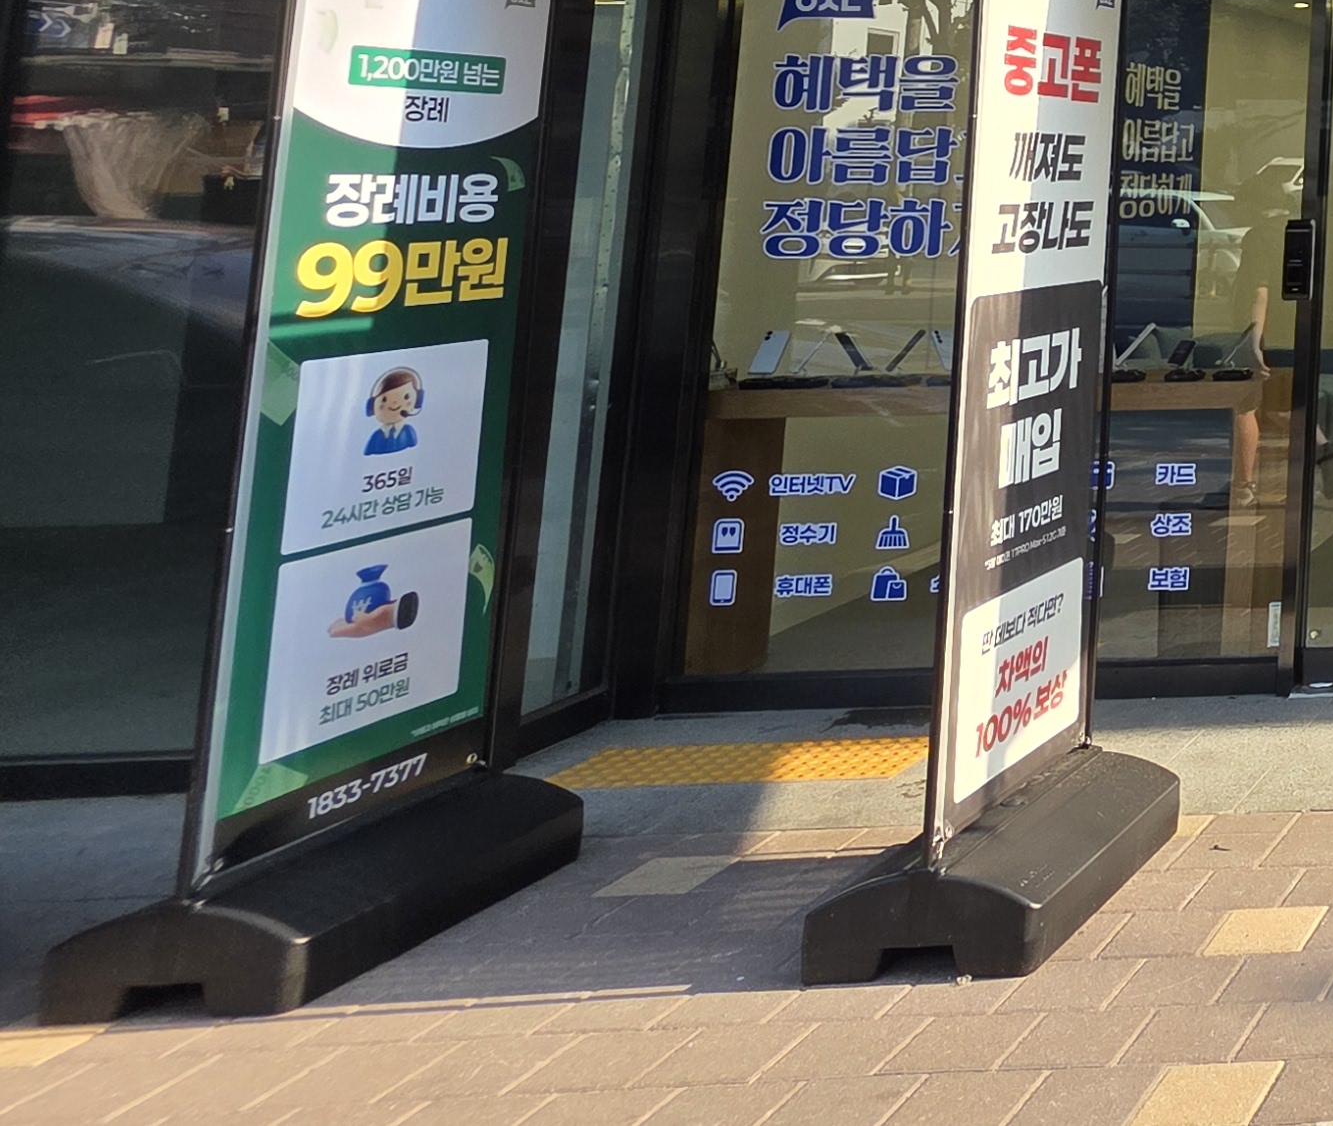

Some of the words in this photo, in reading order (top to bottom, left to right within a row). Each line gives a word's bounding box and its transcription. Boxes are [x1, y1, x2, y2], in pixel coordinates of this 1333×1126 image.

[356, 52, 461, 85] 1,200만원
[463, 59, 501, 88] 넘는
[773, 53, 961, 113] 혜택을
[1003, 24, 1102, 104] 중고폰
[1124, 61, 1182, 111] 혜택을
[404, 95, 450, 123] 장례
[767, 125, 963, 186] 아름답
[1008, 131, 1086, 183] 깨져도
[1122, 117, 1195, 163] 아름답고
[325, 173, 499, 228] 장례비용
[1119, 170, 1193, 219] 정당하게
[991, 199, 1096, 255] 고장나도
[295, 237, 510, 319] 99만원
[985, 326, 1082, 411] 최고가
[997, 407, 1063, 491] 매입
[361, 466, 414, 494] 365일
[768, 473, 855, 497] 인터넷TV
[1155, 463, 1197, 487] 카드
[321, 500, 379, 530] 24시간
[380, 491, 414, 517] 상담
[415, 485, 445, 510] 가능
[989, 512, 1015, 547] 최대
[1018, 494, 1064, 533] 170만원
[1150, 513, 1192, 537] 상조
[780, 521, 837, 546] 정수기
[774, 574, 833, 598] 휴대폰
[1148, 567, 1190, 592] 보험
[981, 630, 994, 656] 딴
[994, 615, 1026, 649] 데보다
[1026, 592, 1065, 627] 적다면?
[326, 669, 359, 697] 장례
[362, 652, 409, 685] 위로금
[995, 635, 1050, 698] 차액의
[319, 697, 354, 727] 최대
[355, 677, 411, 714] 50만원
[975, 691, 1032, 759] 100%
[1033, 669, 1068, 721] 보상
[305, 752, 429, 820] 1833-7377
